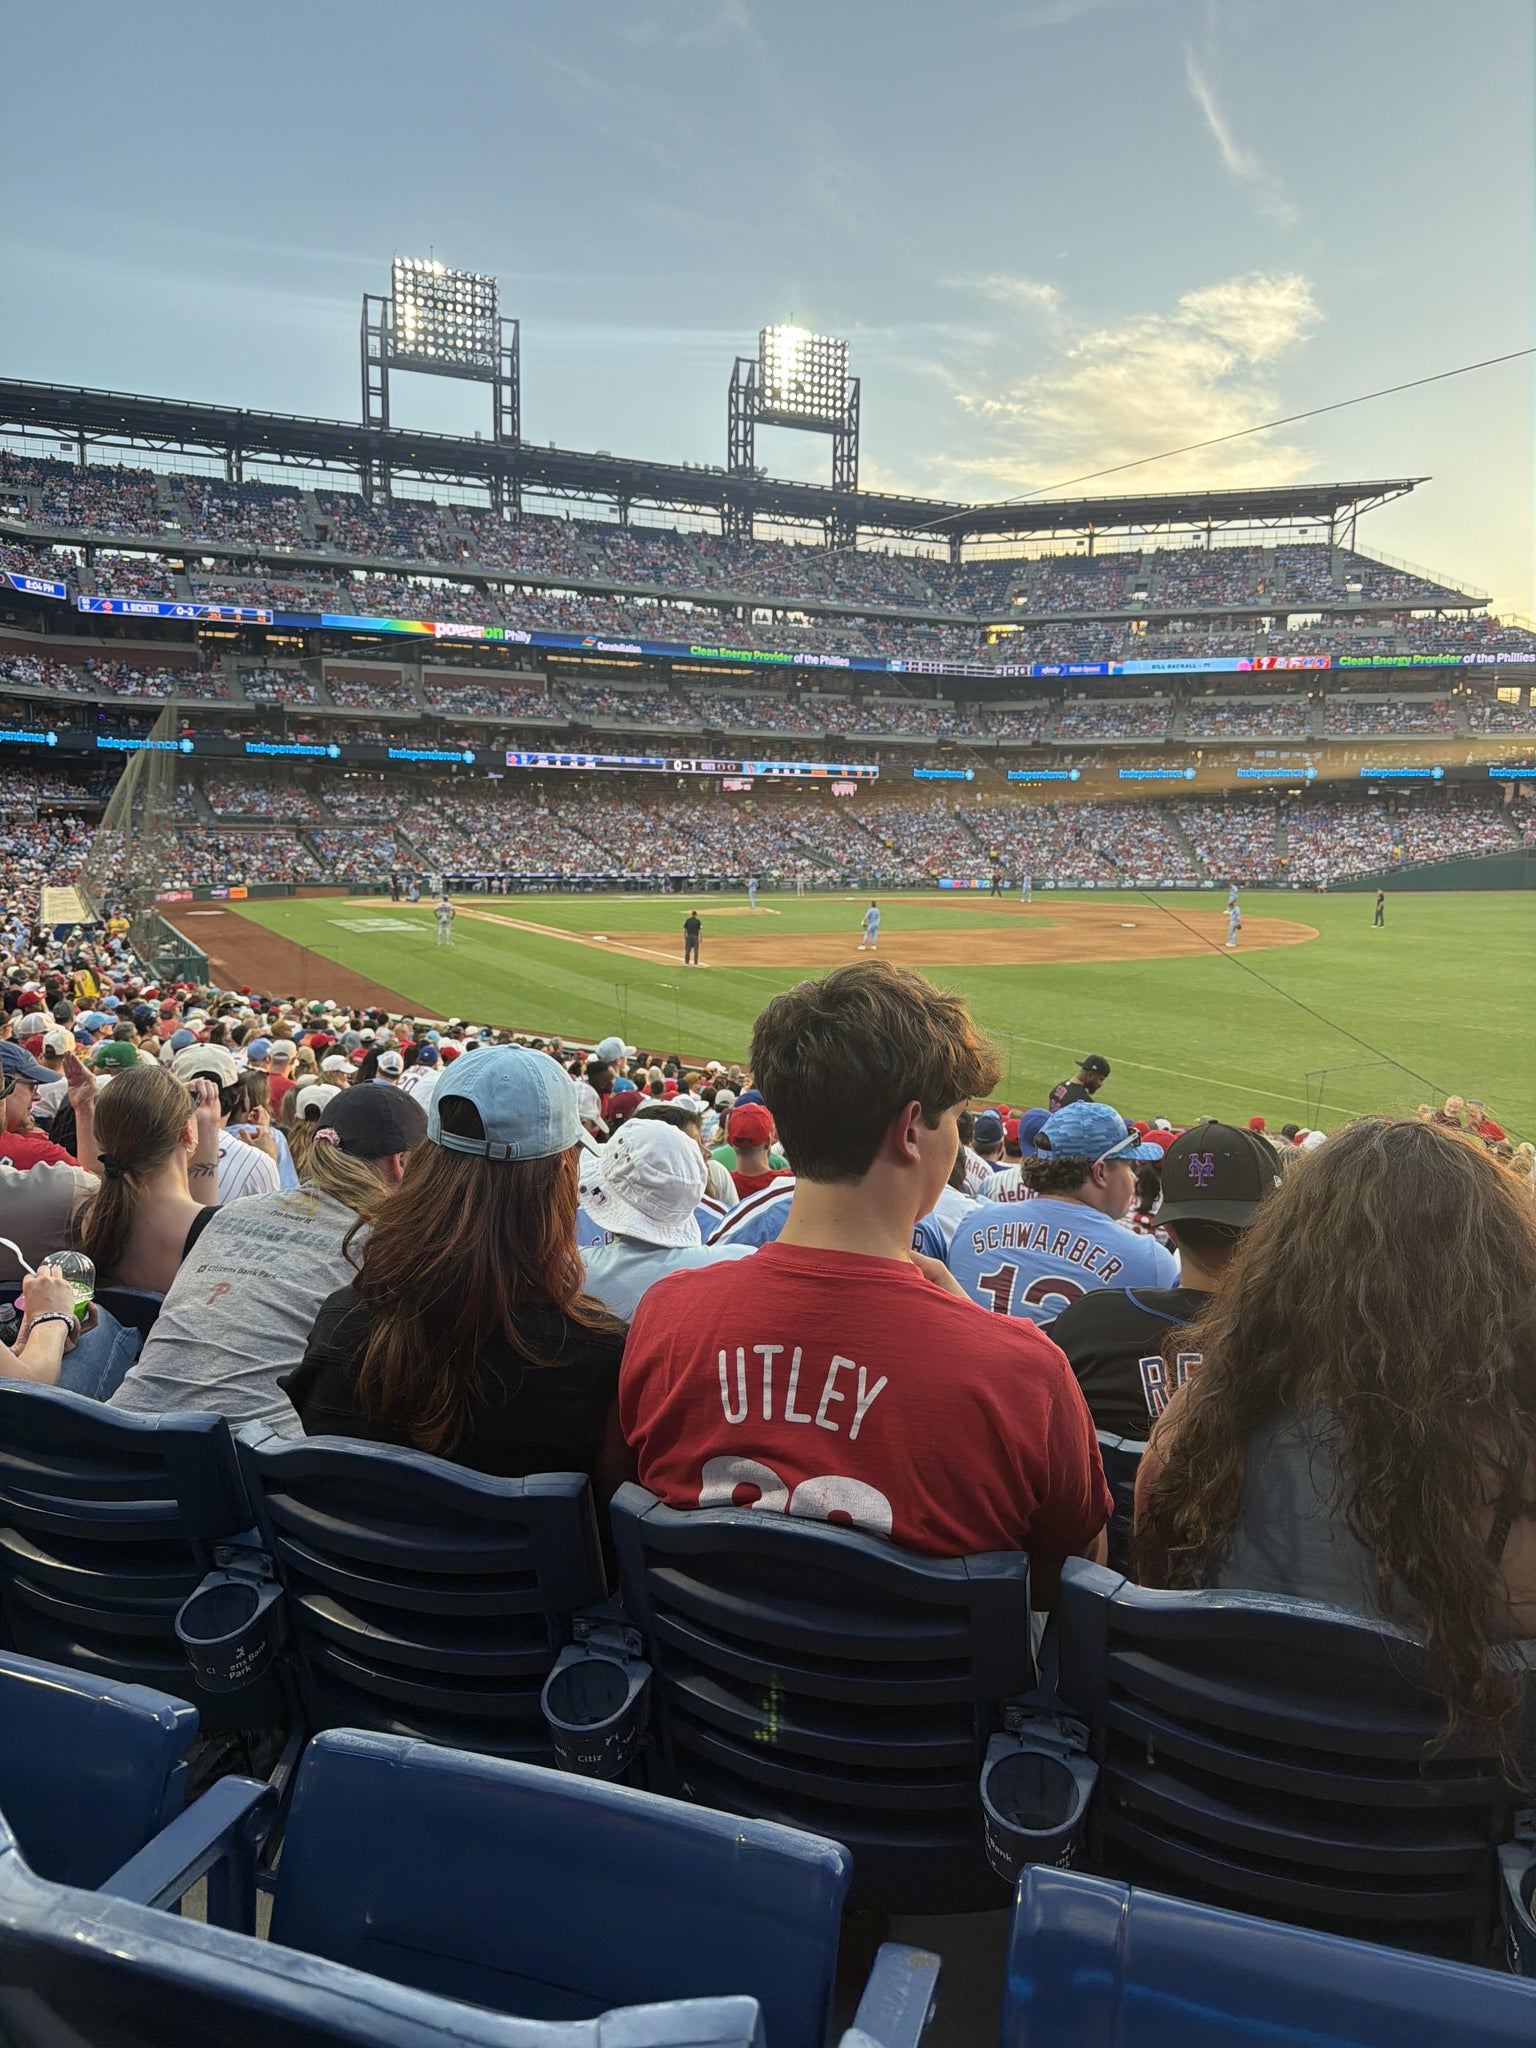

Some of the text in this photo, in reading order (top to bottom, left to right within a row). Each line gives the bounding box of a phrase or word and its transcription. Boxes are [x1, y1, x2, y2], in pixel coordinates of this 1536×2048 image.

[25, 579, 55, 593] 8:04 PM
[131, 603, 160, 614] BICHETTE
[504, 629, 532, 645] Philly
[690, 645, 850, 667] Clean Energy Provider of the Phillies
[1338, 652, 1536, 667] Clean Energy Provider of the Phillies
[97, 736, 178, 751] Independence
[246, 741, 326, 757] Independence
[388, 747, 462, 762] Independence
[914, 768, 964, 780] Independence
[1008, 769, 1068, 780] Independence
[1119, 768, 1183, 779] Independence
[1237, 767, 1304, 779] Independence
[1360, 767, 1431, 779] Independence
[972, 1221, 1124, 1285] SCHWARBER
[208, 1264, 278, 1280] Citizens Bank Park
[718, 1343, 889, 1440] UTLEY
